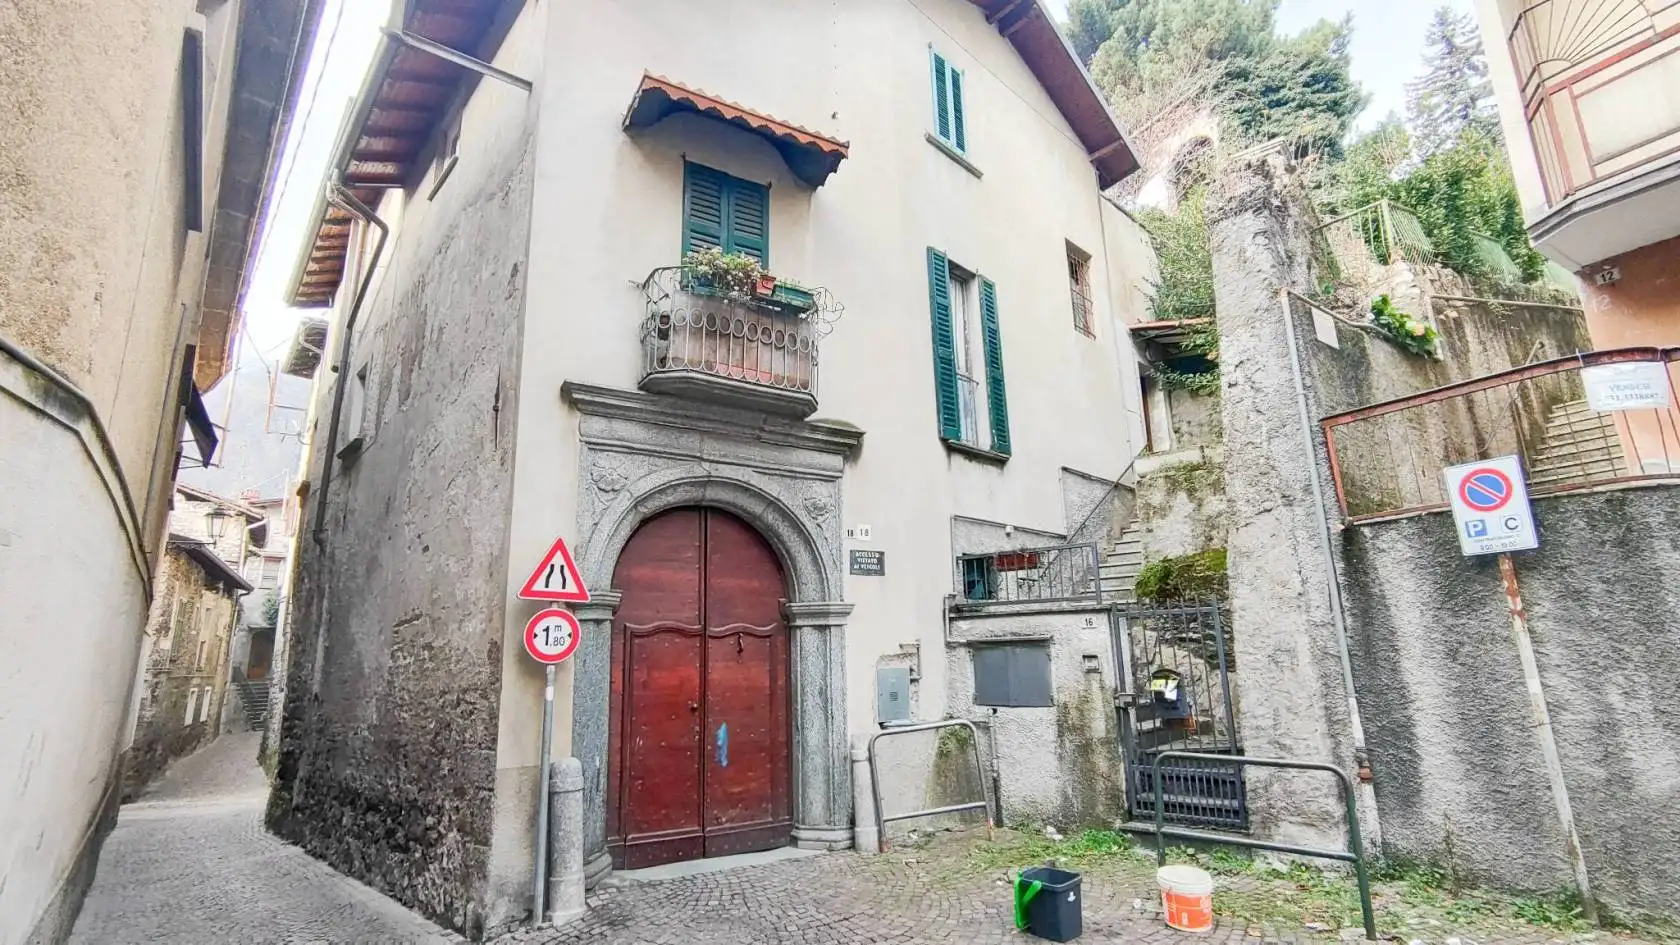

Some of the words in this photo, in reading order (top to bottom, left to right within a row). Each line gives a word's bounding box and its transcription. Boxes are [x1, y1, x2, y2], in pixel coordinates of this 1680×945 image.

[1601, 270, 1615, 282] 12
[1467, 521, 1484, 537] P
[1504, 517, 1519, 530] C
[847, 529, 854, 537] 18
[1085, 617, 1094, 626] 16
[554, 624, 562, 632] m
